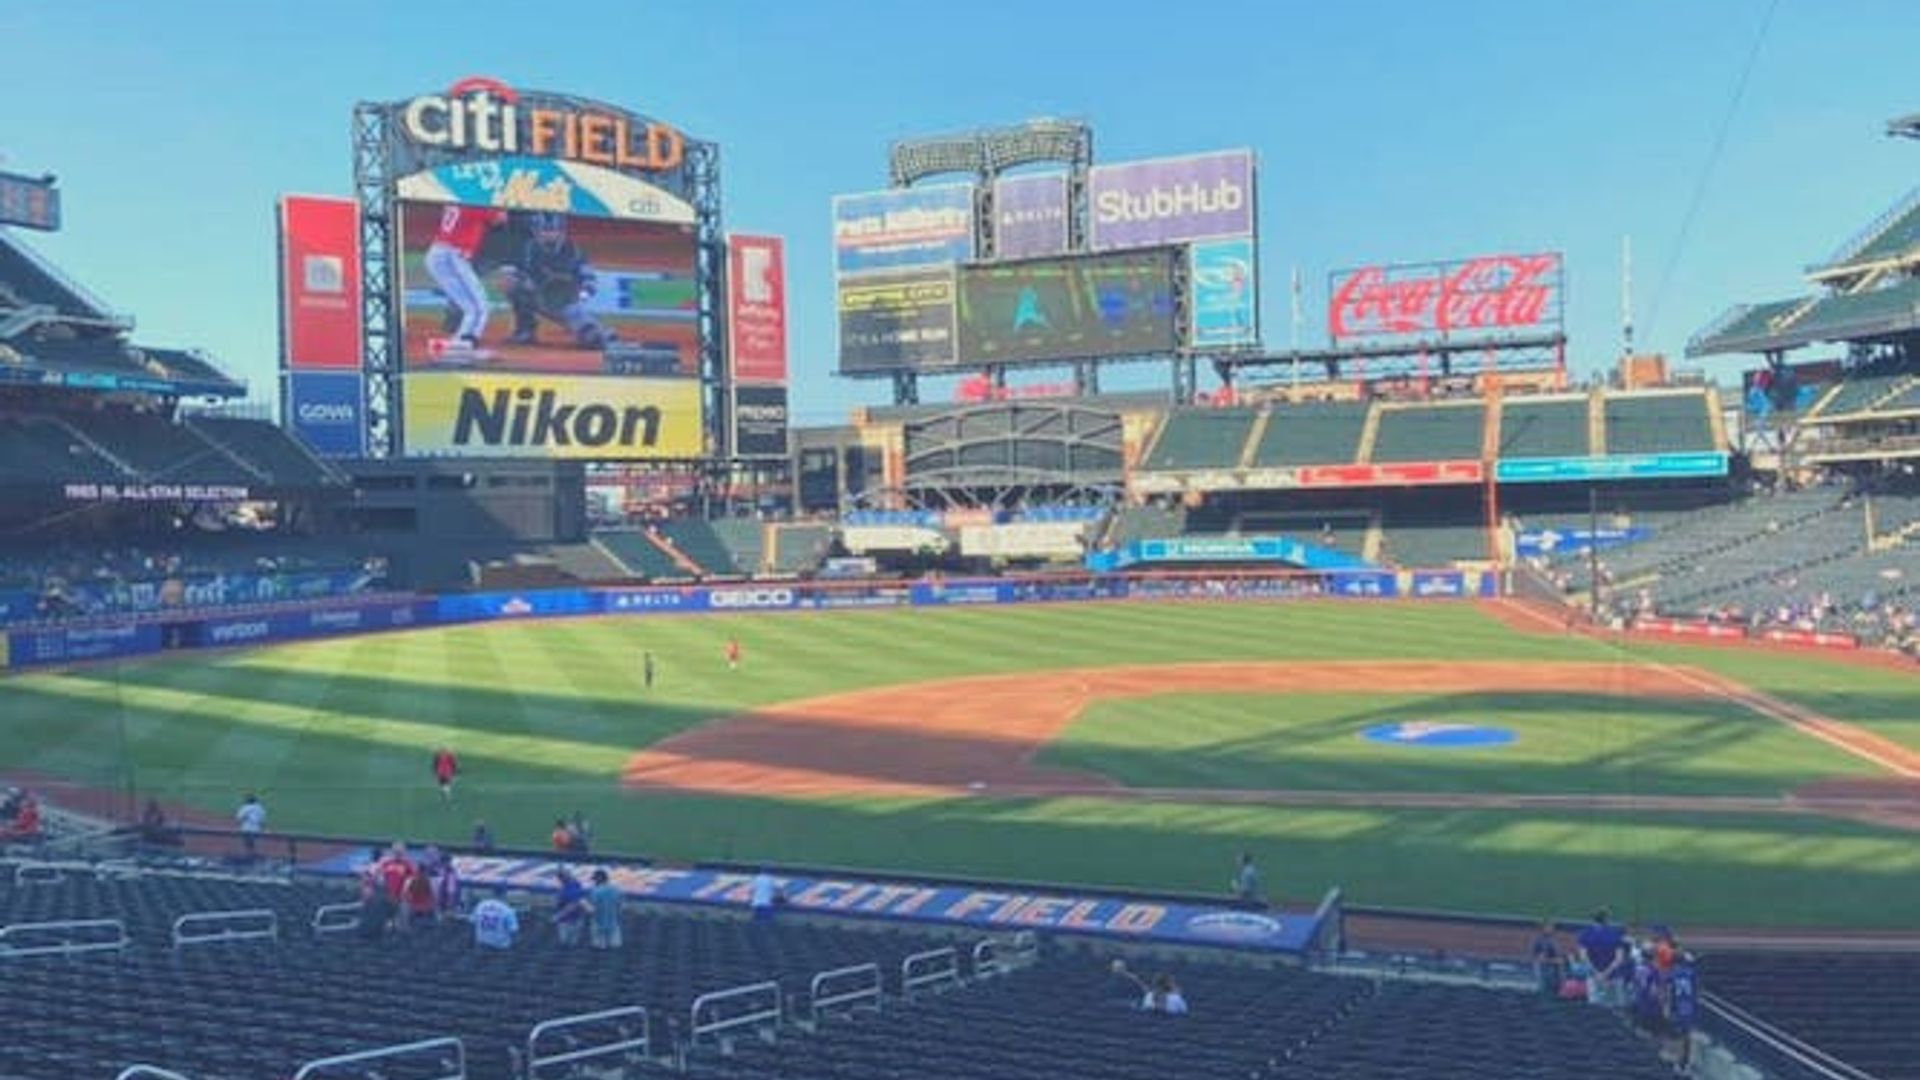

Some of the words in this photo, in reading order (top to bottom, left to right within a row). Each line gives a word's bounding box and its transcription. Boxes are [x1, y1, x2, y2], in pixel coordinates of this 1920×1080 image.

[405, 90, 517, 152] citi
[530, 108, 685, 173] FIELD
[1098, 178, 1243, 224] StubHub
[452, 387, 662, 447] Nikon
[631, 594, 681, 606] DELTA
[711, 589, 793, 608] GEICO
[795, 880, 940, 916] CITI
[944, 892, 1168, 932] FIELD
